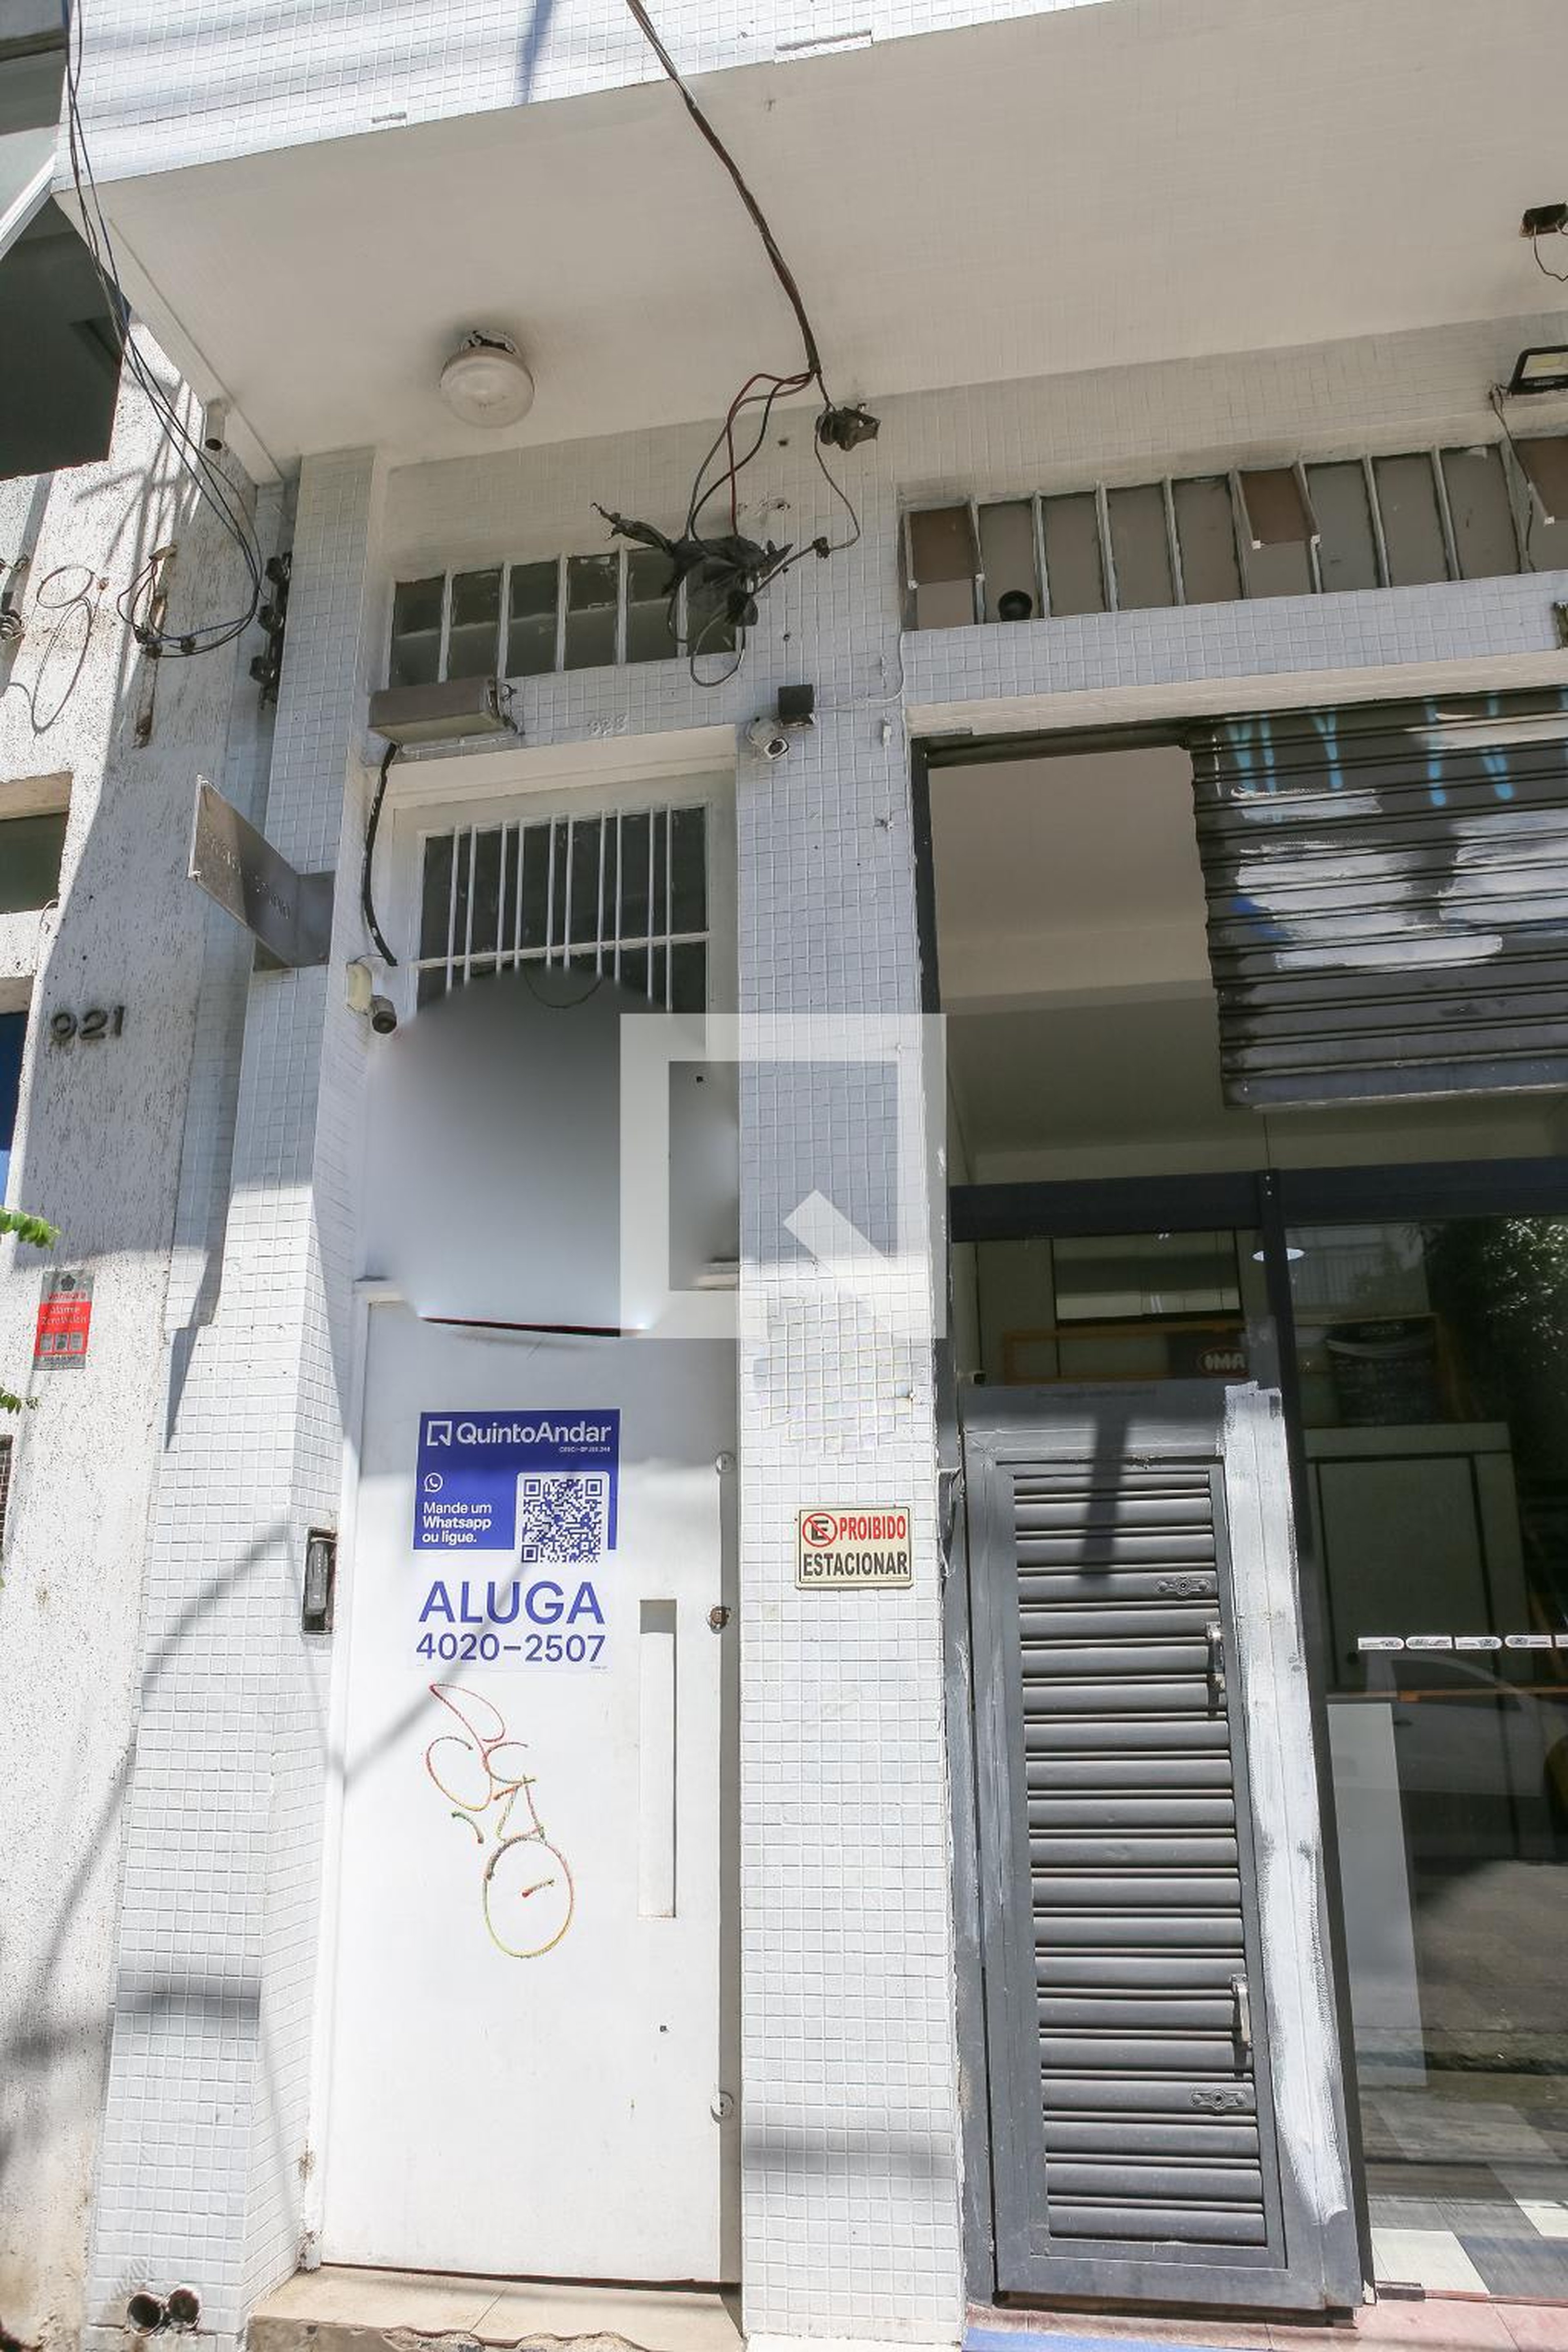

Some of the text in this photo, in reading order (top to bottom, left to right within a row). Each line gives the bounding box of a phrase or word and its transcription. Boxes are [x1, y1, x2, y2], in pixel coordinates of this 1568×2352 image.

[51, 1005, 125, 1041] 921
[457, 1421, 612, 1446] QuintoAndar
[424, 1503, 492, 1514] Mande um
[423, 1517, 491, 1530] Whatsapp
[840, 1516, 906, 1540] PROIBIDO
[423, 1530, 477, 1546] ou ligue.
[803, 1552, 908, 1576] ESTACIONAR
[419, 1581, 605, 1625] ALUGA
[416, 1633, 606, 1662] 4020-2507
